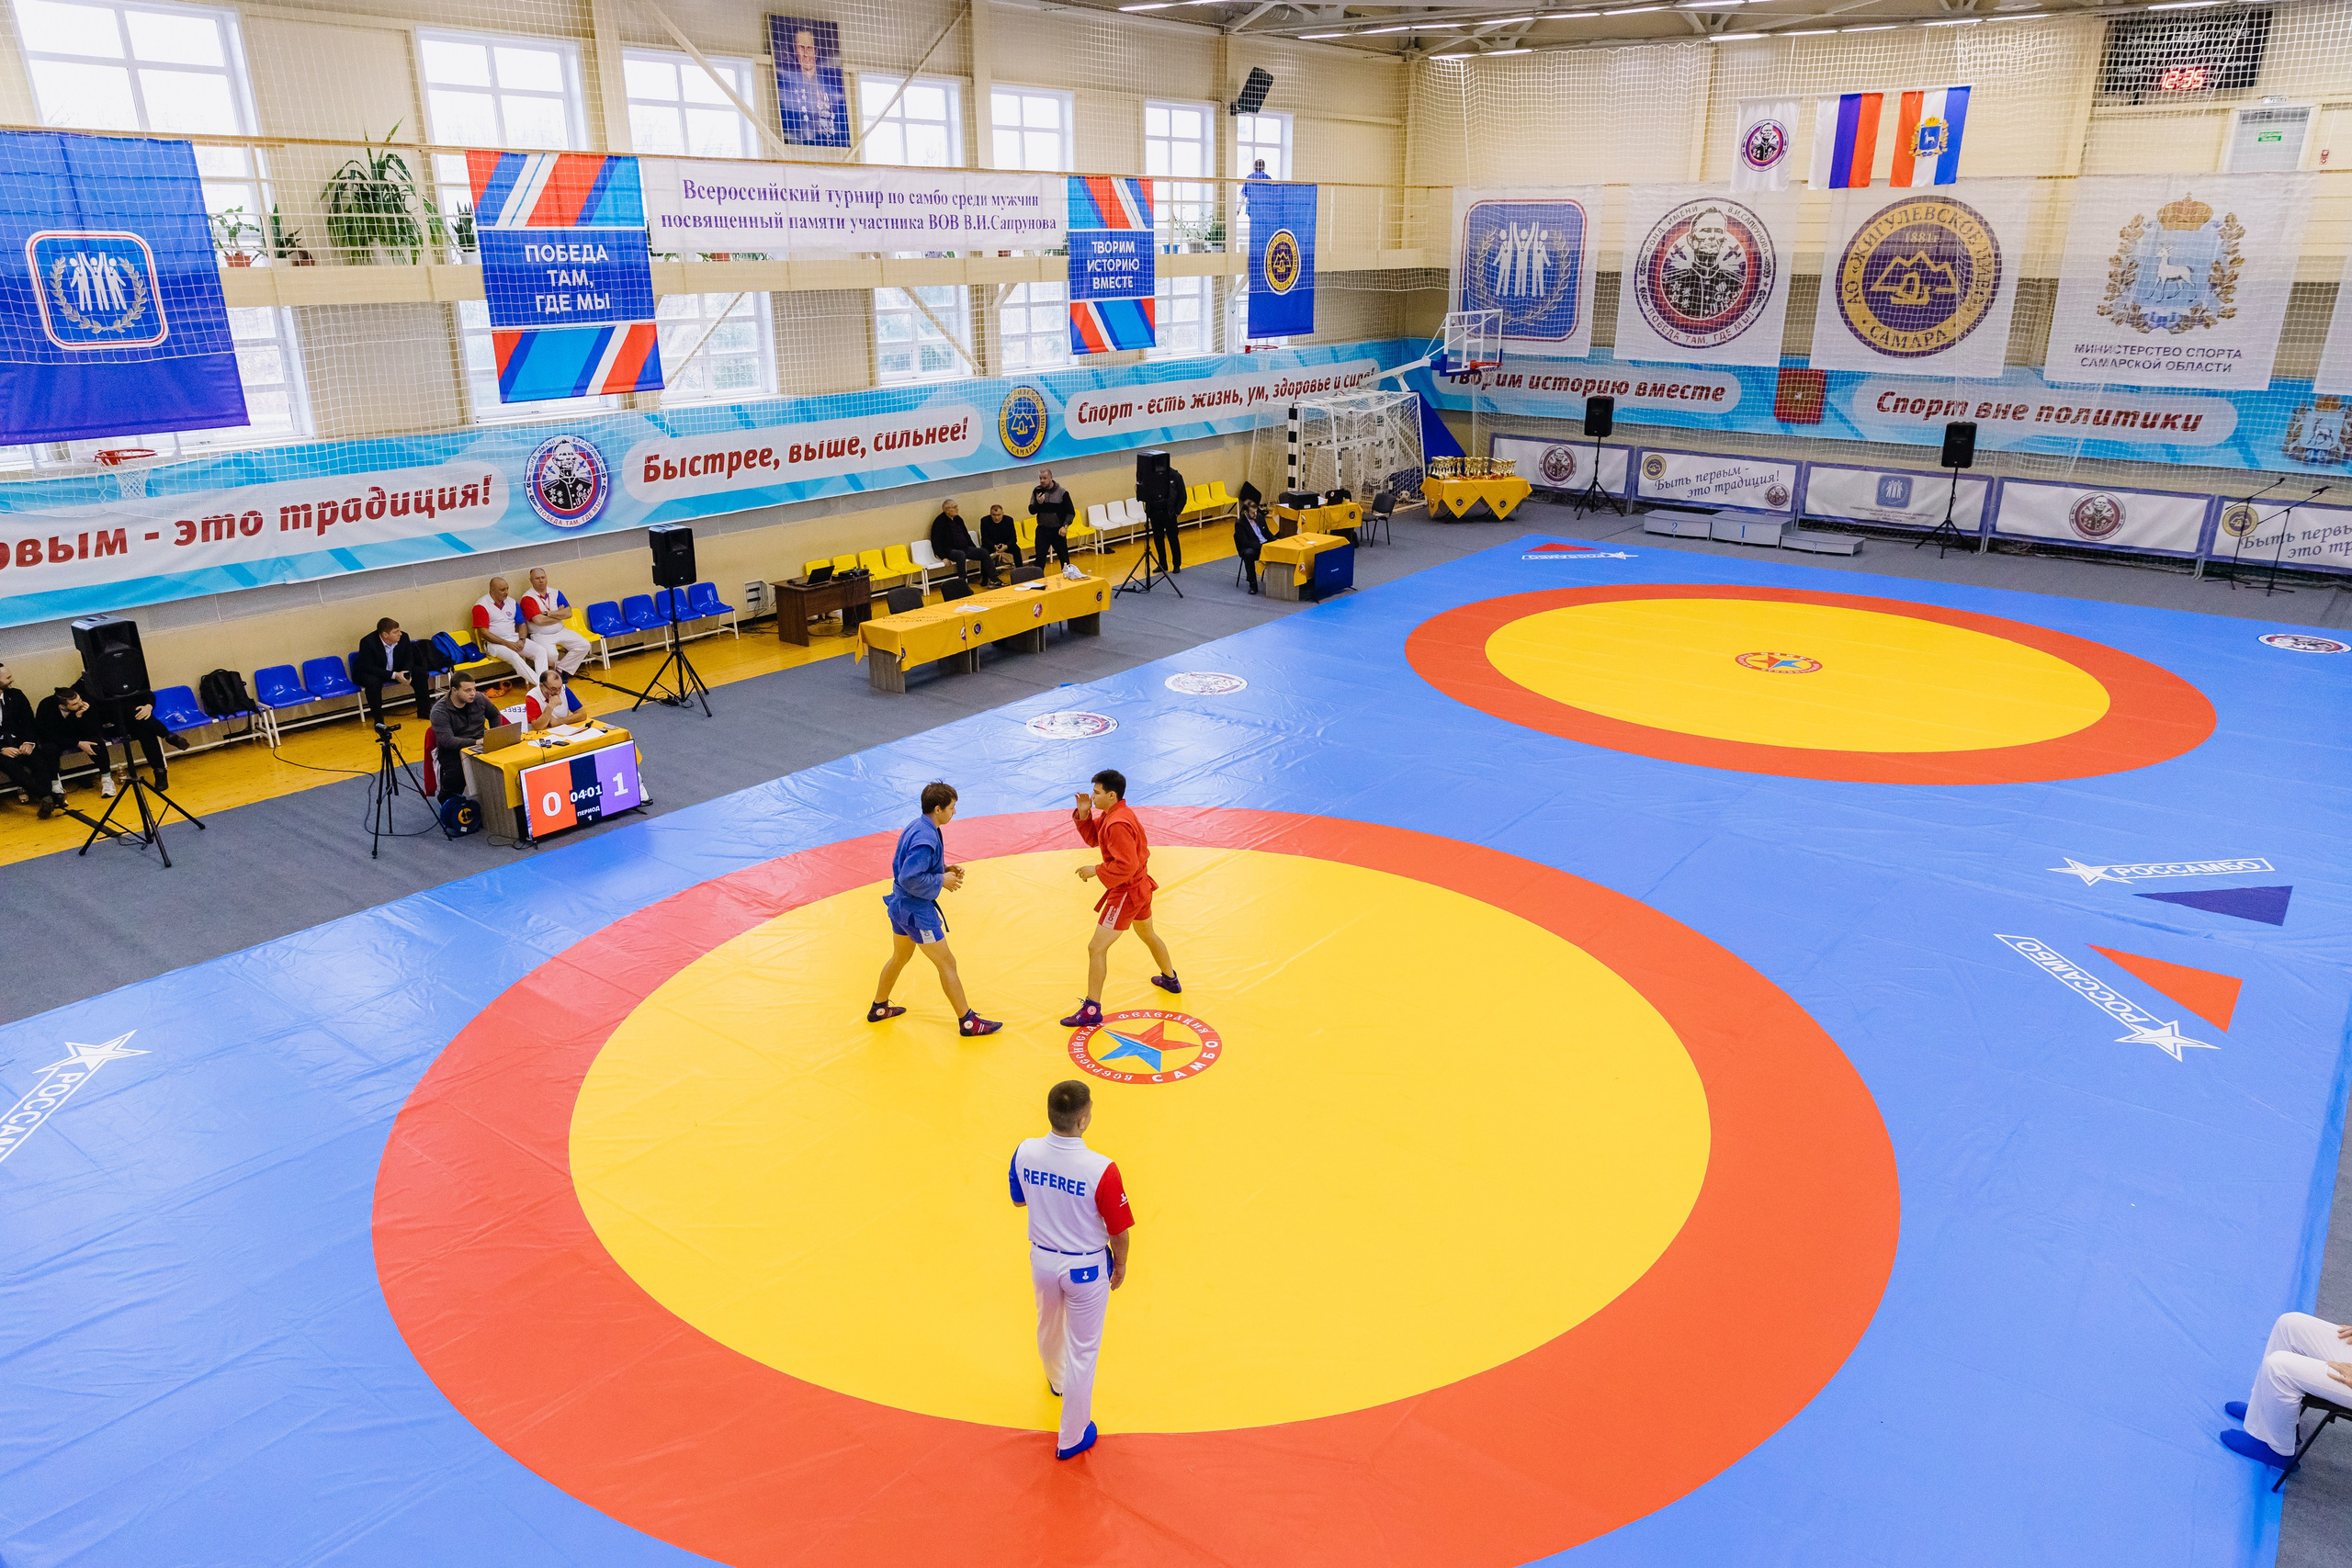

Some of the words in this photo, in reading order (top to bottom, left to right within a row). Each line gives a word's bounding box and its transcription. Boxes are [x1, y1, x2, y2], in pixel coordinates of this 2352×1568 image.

[2162, 69, 2206, 89] 12:35
[683, 179, 820, 206] Всероссийский
[825, 189, 884, 209] турнир
[888, 192, 905, 205] по
[909, 188, 948, 206] самбо
[952, 193, 988, 209] среди
[991, 195, 1039, 210] мужчин
[661, 211, 784, 230] посвященный
[788, 216, 845, 230] памяти
[850, 217, 924, 233] участника
[928, 213, 959, 230] ВОВ
[964, 214, 1057, 233] В.И.Сапрунова
[1646, 227, 1666, 252] ФОНД
[1668, 206, 1698, 226] ИМЕНИ
[525, 244, 609, 264] ПОБЕДА
[1091, 241, 1136, 254] ТВОРИМ
[1086, 258, 1139, 272] ИСТОРИЮ
[547, 269, 594, 288] ТАМ,
[1092, 276, 1134, 289] ВМЕСТЕ
[536, 294, 572, 314] ГДЕ
[577, 293, 611, 310] МЫ
[1845, 280, 1862, 305] АО
[1647, 308, 1679, 340] ПОБЕДА
[1713, 330, 1733, 343] ГДЕ
[1870, 325, 1948, 349] САМАРА
[2075, 344, 2182, 356] МИНИСТЕРСТВО
[2186, 347, 2243, 359] СПОРТА
[2080, 357, 2162, 370] САМАРСКОЙ
[2165, 361, 2233, 373] ОБЛАСТИ
[1528, 374, 1630, 398] историю
[1635, 380, 1726, 402] вместе
[1078, 400, 1133, 426] Спорт
[1147, 394, 1185, 415] есть
[1190, 389, 1244, 411] жизнь,
[1247, 384, 1270, 408] ум,
[1272, 376, 1331, 400] здоровье
[1334, 376, 1340, 389] и
[1876, 390, 1969, 421] Спорт
[1974, 400, 2030, 421] вне
[2035, 402, 2204, 433] политики
[643, 446, 781, 483] Быстрее,
[788, 436, 866, 464] выше,
[874, 416, 968, 452] сильнее!
[1011, 444, 1037, 456] САМАРА
[1655, 476, 1691, 491] Быть
[1695, 465, 1742, 485] первым
[1687, 486, 1711, 499] это
[1714, 469, 1780, 495] традиция!
[174, 510, 265, 547] это
[279, 474, 492, 536] традиция!
[1671, 522, 1678, 533] 2
[1740, 525, 1746, 538] 1
[2240, 532, 2296, 549] Быть
[2287, 545, 2323, 558] это
[570, 784, 603, 803] 04:01
[612, 773, 628, 796] 1
[542, 792, 562, 817] 0
[577, 806, 601, 817] ПЕРИОД
[2111, 859, 2261, 878] РОССАМБО
[2016, 940, 2152, 1024] РОССАМБО
[1118, 1011, 1211, 1034] ФЕДЕРАЦИЯ
[1151, 1040, 1219, 1083] САМБО
[1023, 1168, 1086, 1197] REFEREE
